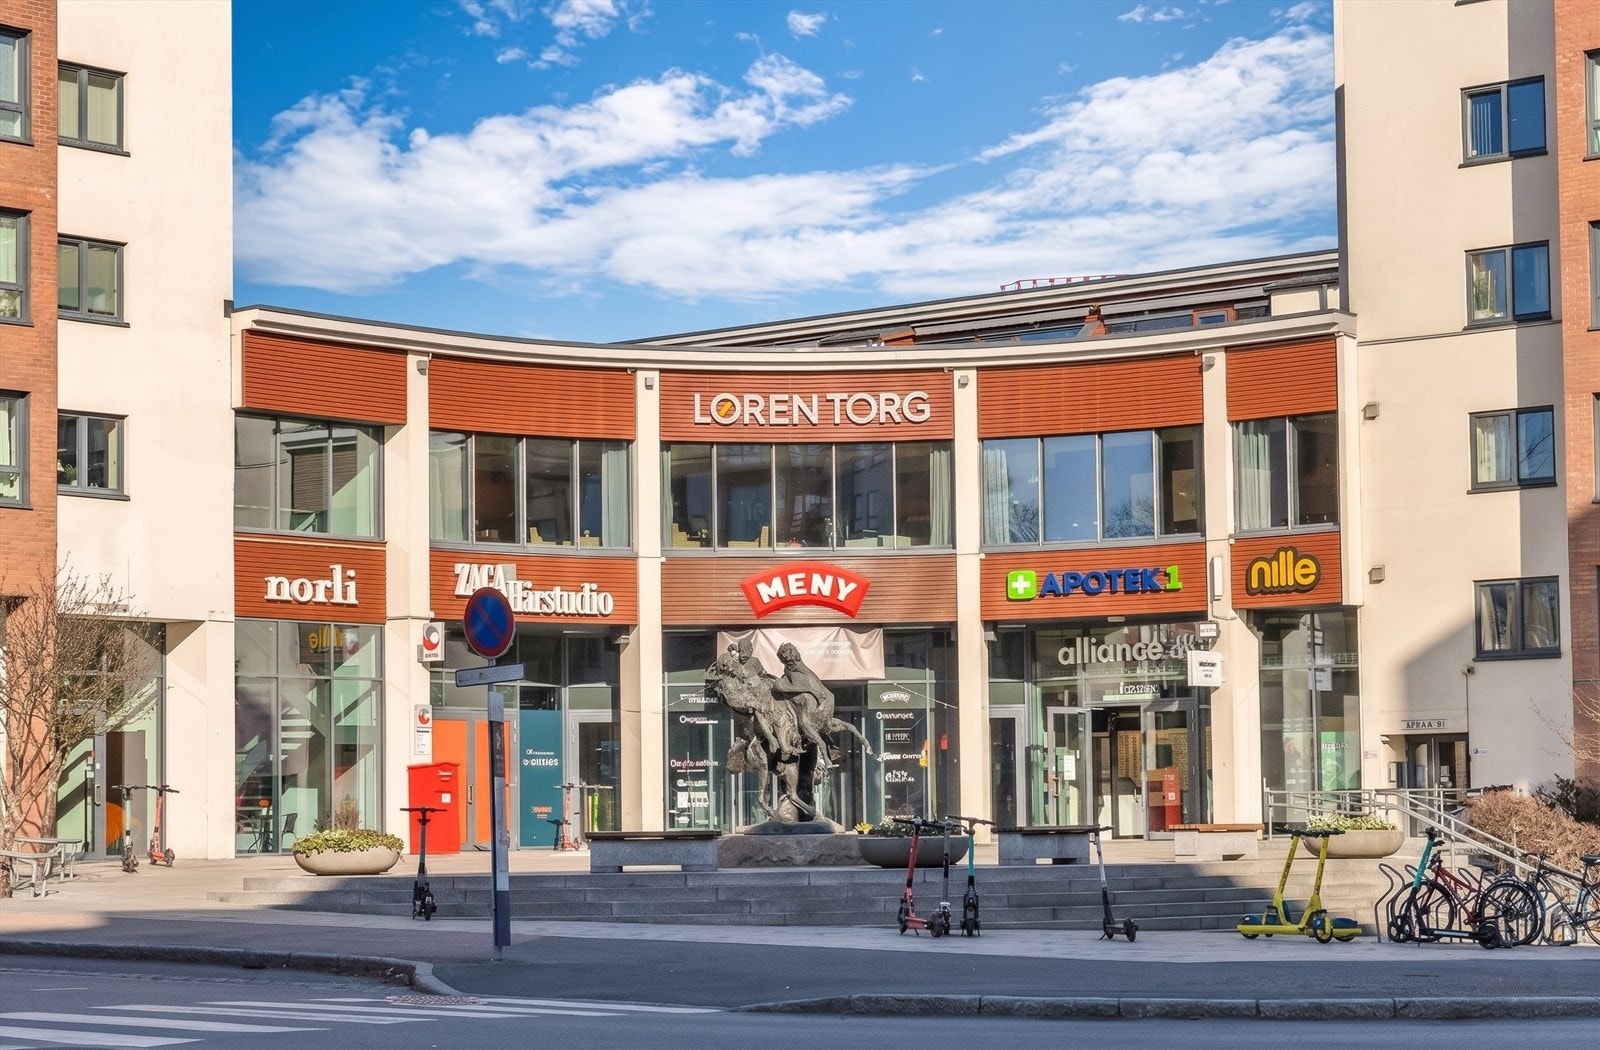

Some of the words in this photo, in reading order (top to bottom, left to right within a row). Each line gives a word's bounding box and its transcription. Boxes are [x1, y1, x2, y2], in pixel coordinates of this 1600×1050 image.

[826, 390, 931, 425] TORG
[264, 564, 359, 605] norli
[1251, 549, 1318, 589] nille
[756, 572, 858, 604] MENY
[1058, 636, 1164, 666] alliance
